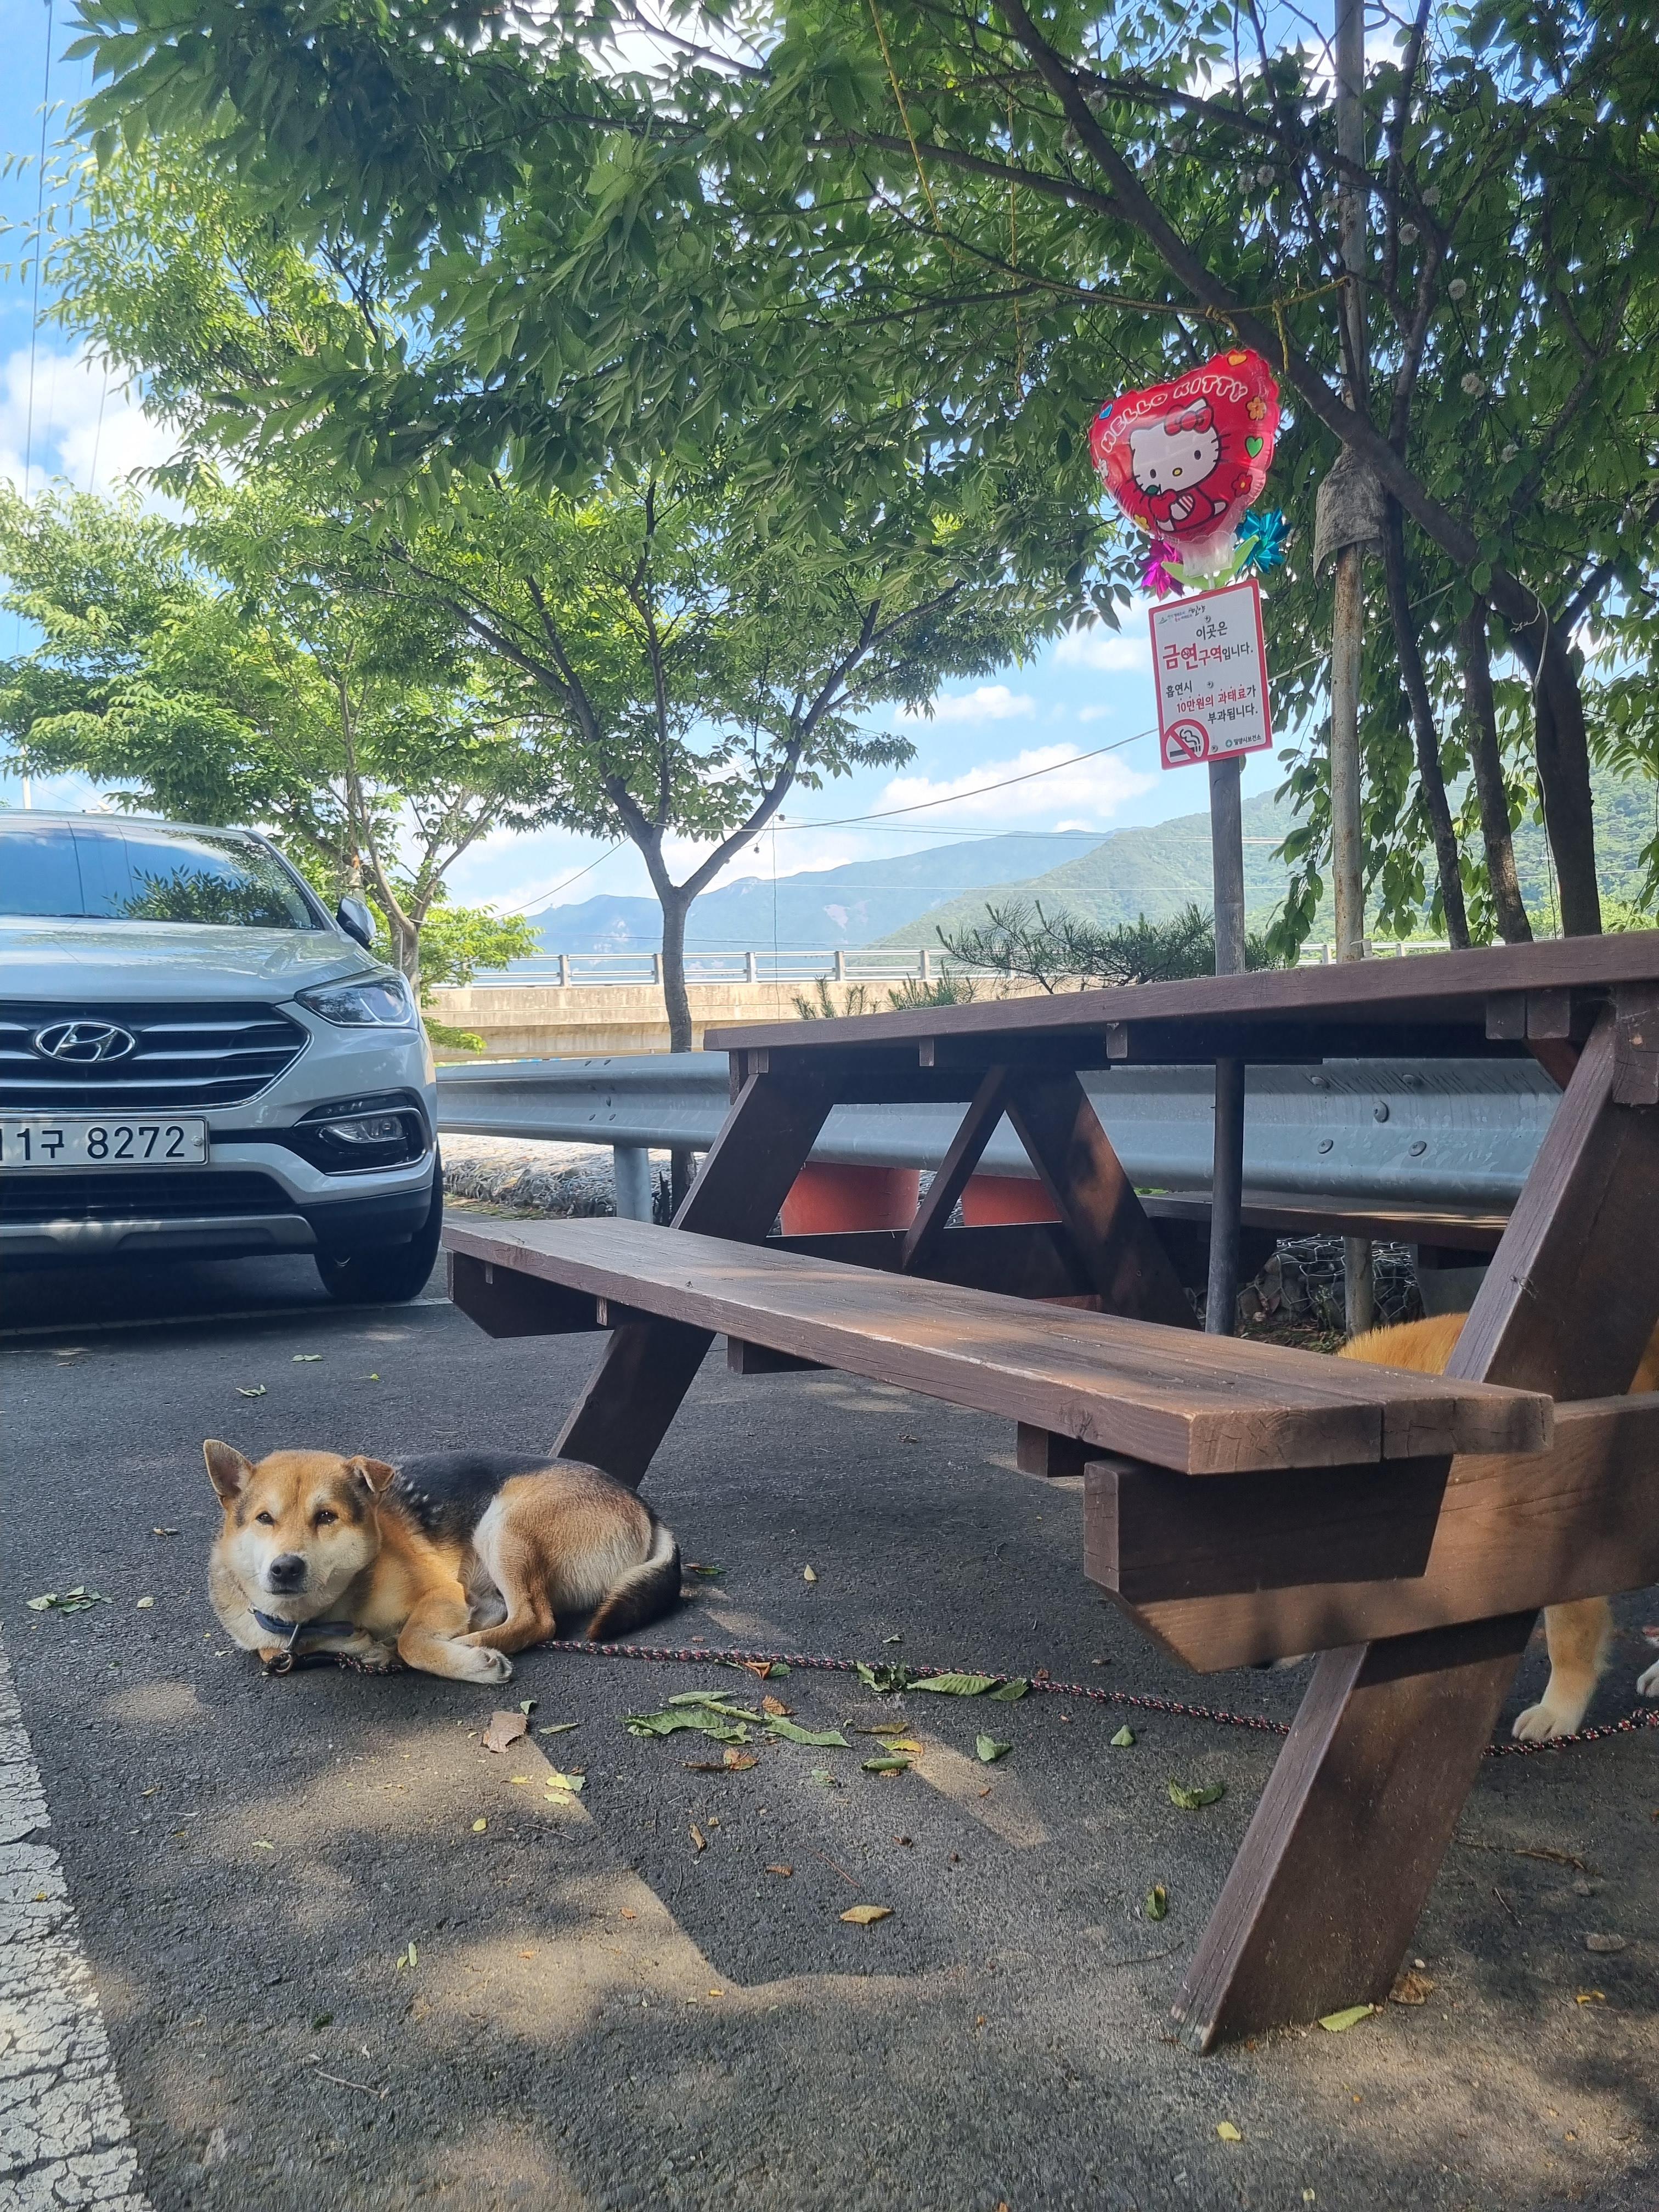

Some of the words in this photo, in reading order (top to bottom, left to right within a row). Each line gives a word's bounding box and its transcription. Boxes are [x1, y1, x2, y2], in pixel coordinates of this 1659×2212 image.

[1101, 393, 1168, 454] HELLO
[1173, 375, 1249, 403] KITTY
[1196, 620, 1228, 641] 이곳은
[1163, 642, 1253, 670] 금연구역입니다.
[1166, 680, 1193, 698] 흡연시
[1176, 694, 1214, 714] 10만원의
[1217, 684, 1256, 704] 과태료가
[1207, 703, 1258, 725] 부과됩니다.
[87, 1126, 185, 1159] 8272
